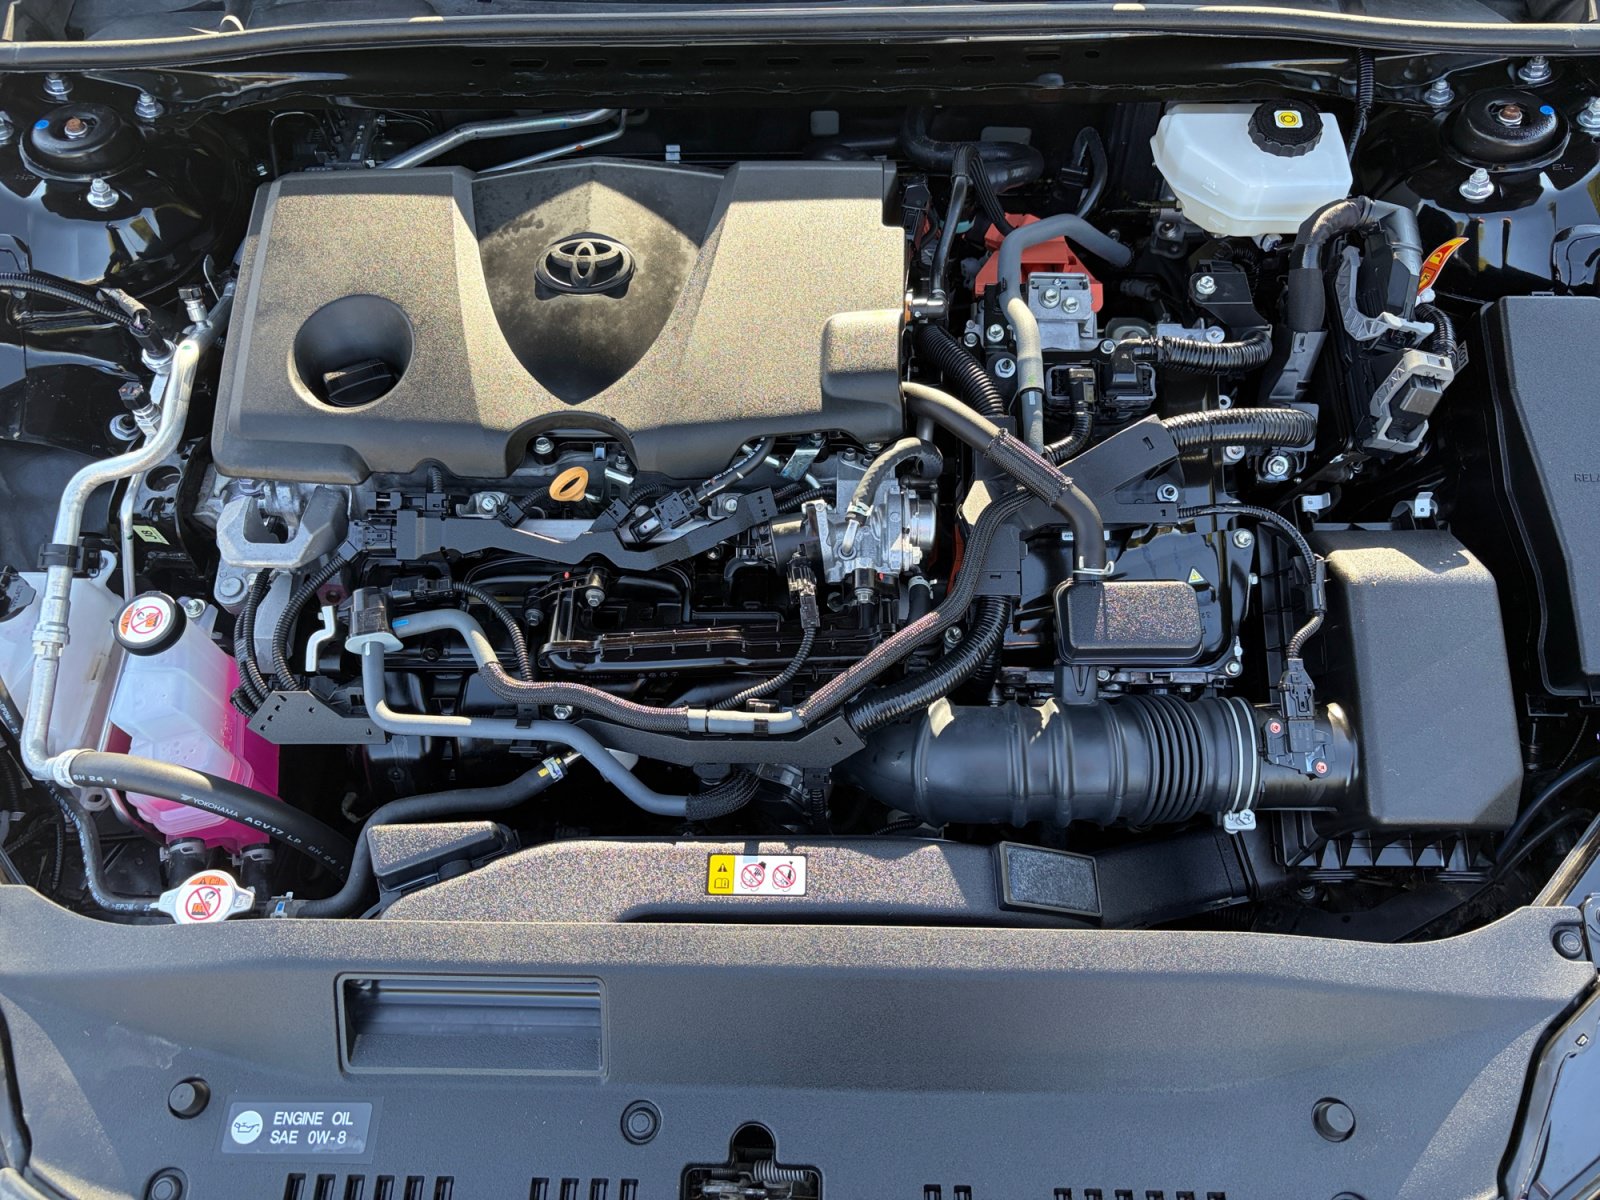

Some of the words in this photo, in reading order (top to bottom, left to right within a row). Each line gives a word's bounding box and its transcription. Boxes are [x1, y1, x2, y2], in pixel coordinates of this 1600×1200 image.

[192, 798, 239, 818] YOKOHAMA
[244, 816, 285, 835] ACV17
[273, 1111, 324, 1126] ENGINE
[331, 1111, 354, 1126] OIL
[269, 1130, 299, 1144] SAE
[307, 1130, 347, 1144] 0W-8
